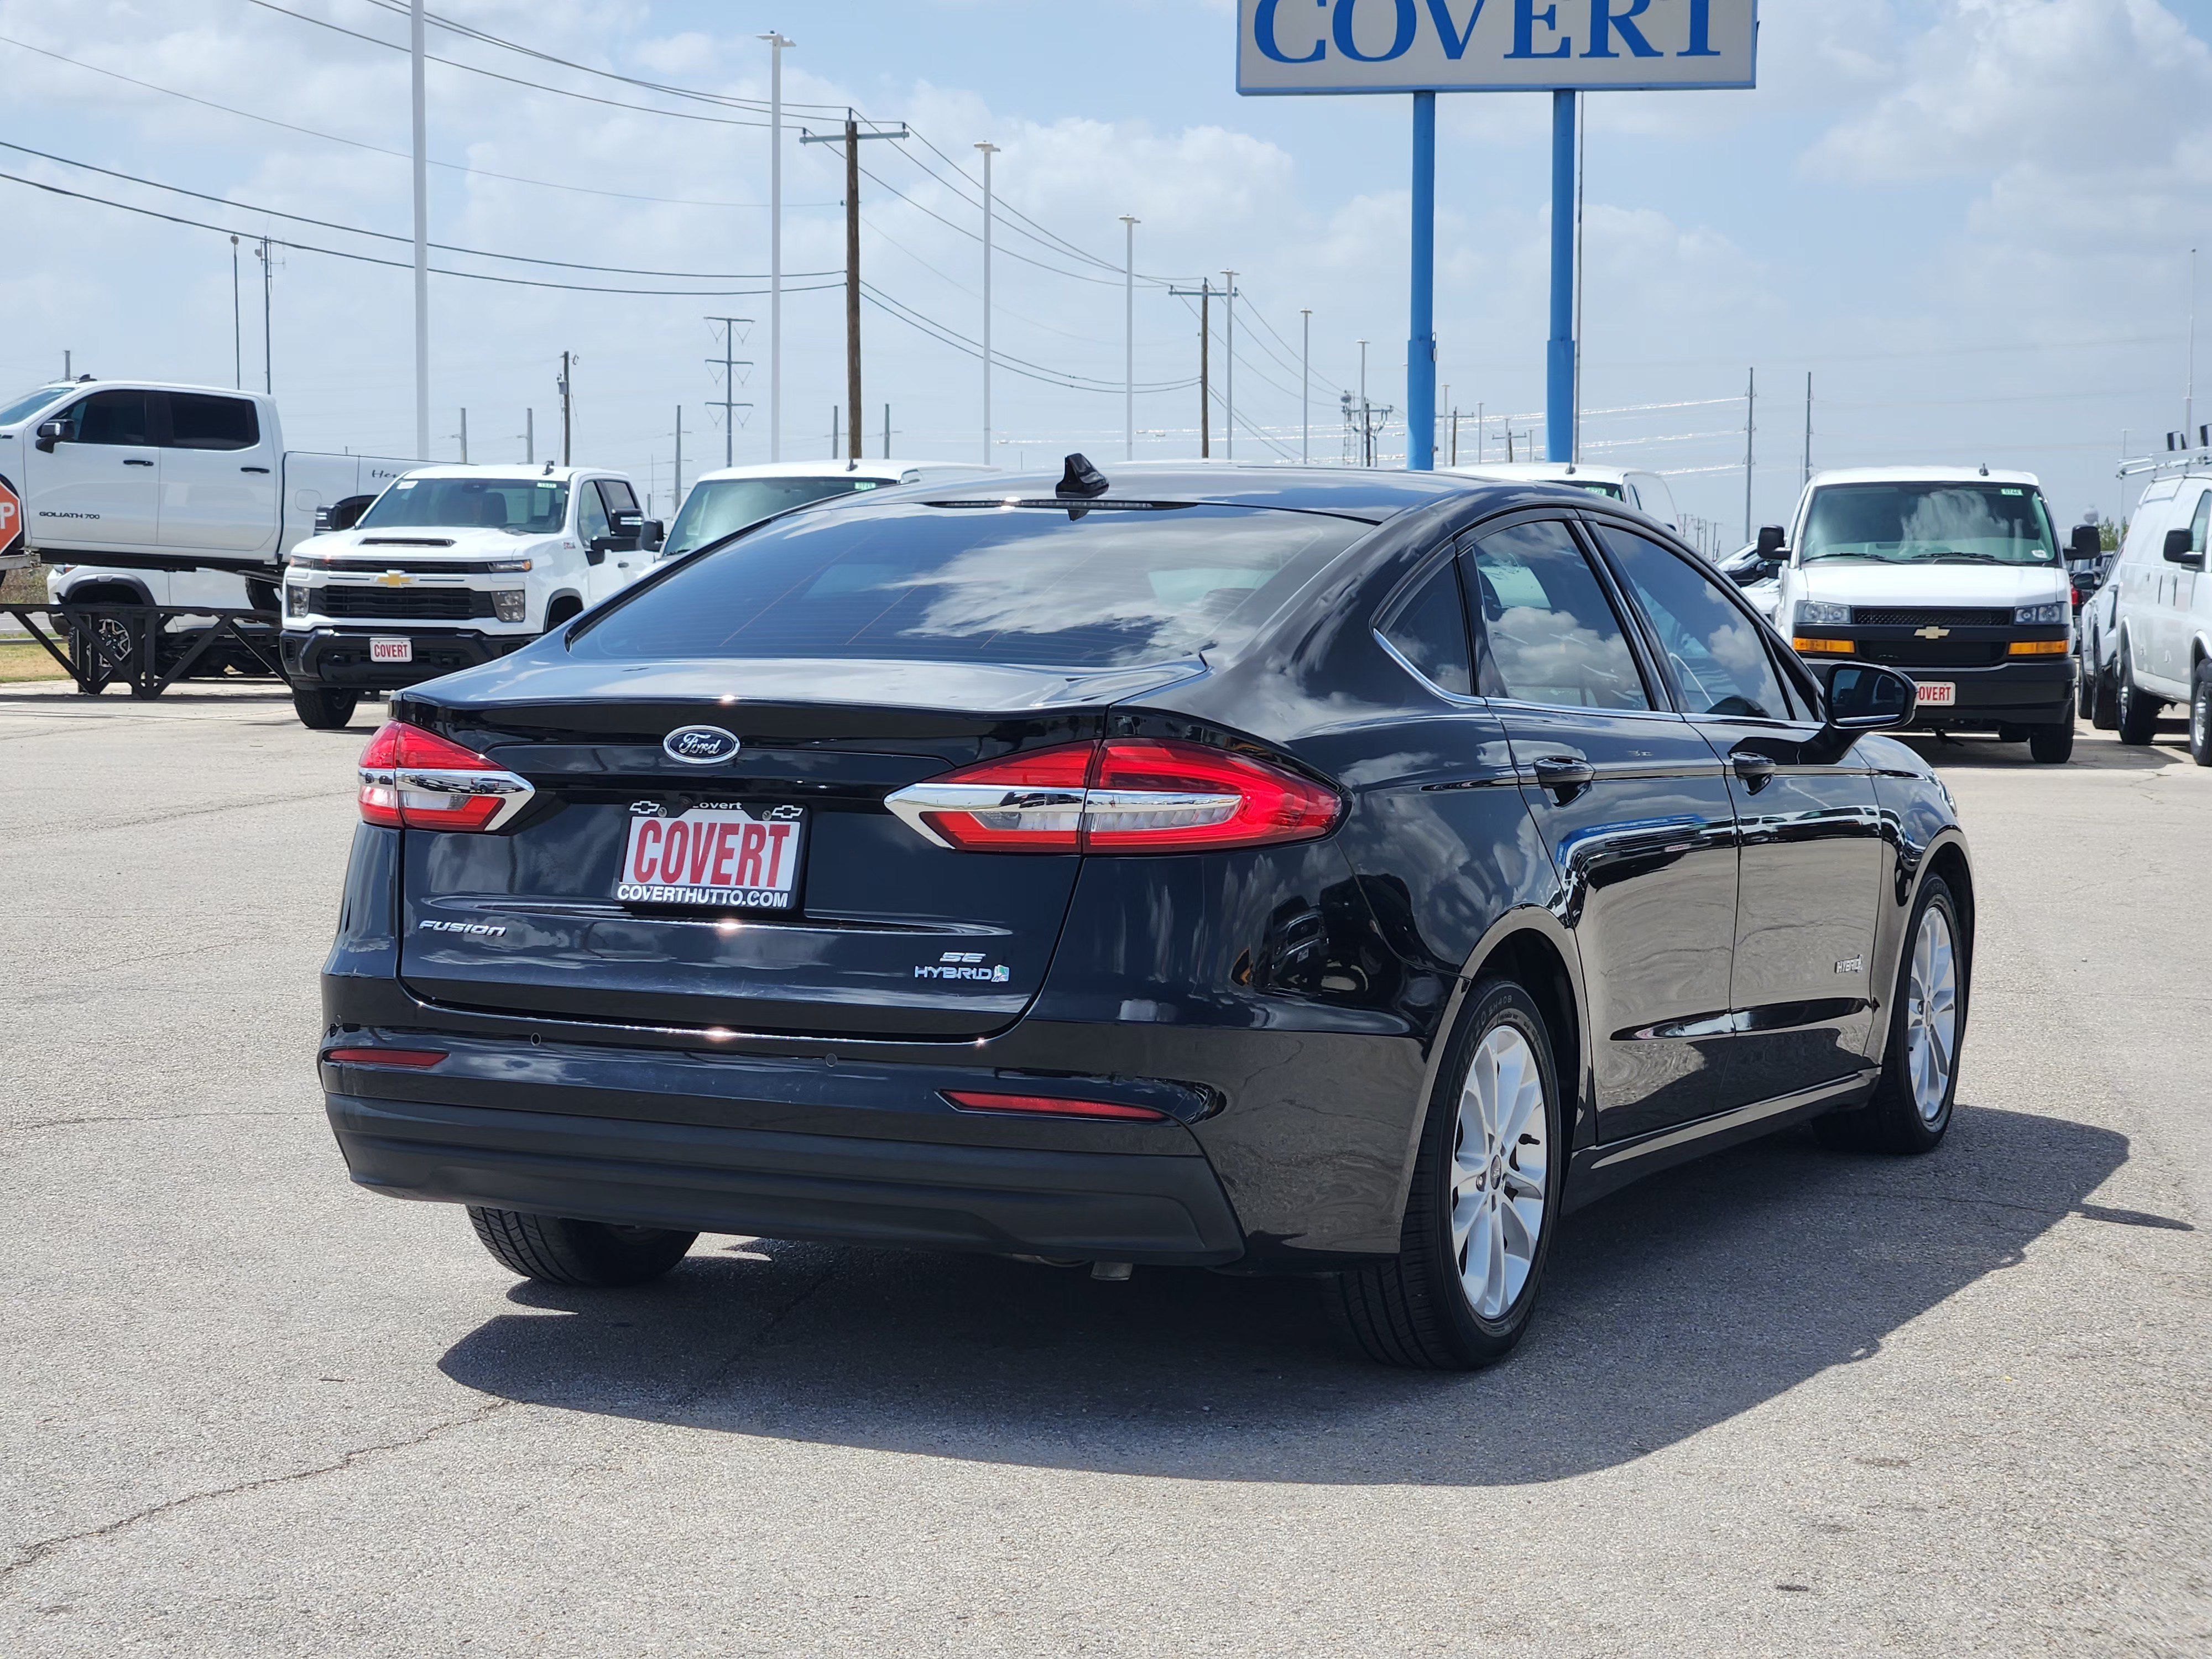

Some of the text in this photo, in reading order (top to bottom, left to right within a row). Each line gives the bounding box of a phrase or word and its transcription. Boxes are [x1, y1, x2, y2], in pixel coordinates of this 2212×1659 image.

[1254, 0, 1721, 64] COVERT
[374, 644, 408, 658] COVERT
[1918, 686, 1951, 701] OVERT
[679, 733, 722, 755] Ford
[633, 819, 791, 888] COVERT
[617, 885, 789, 907] COVERTHUTTO.COM
[418, 920, 507, 936] FUSION
[940, 952, 987, 963] SE
[915, 966, 992, 980] HYBRID
